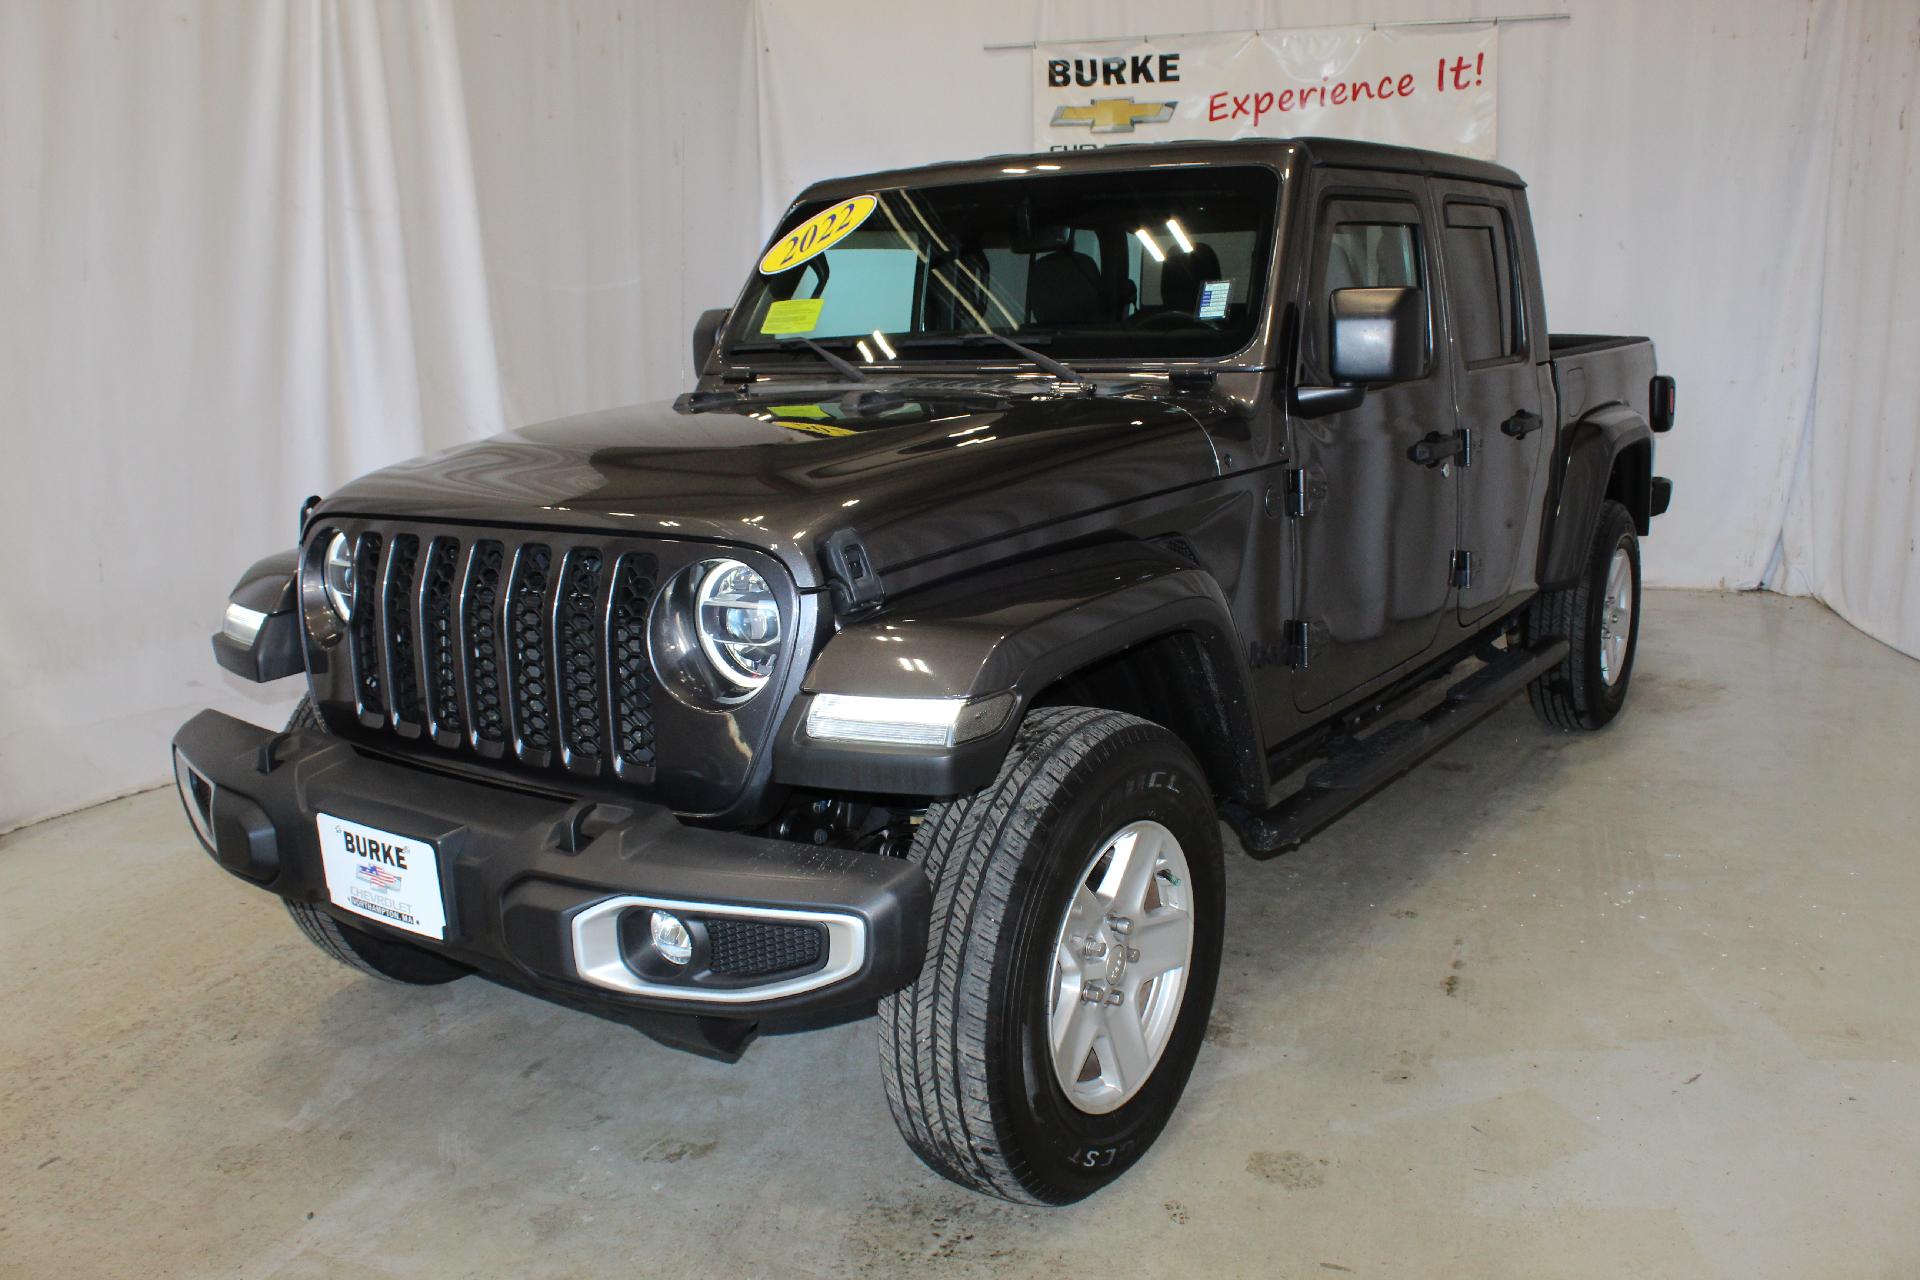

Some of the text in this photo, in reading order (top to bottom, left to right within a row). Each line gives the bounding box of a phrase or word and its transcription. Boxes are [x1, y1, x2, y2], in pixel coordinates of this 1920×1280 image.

[1049, 53, 1180, 87] BURKE
[1208, 52, 1485, 127] Experience It!
[780, 203, 855, 265] 2022
[344, 831, 408, 870] BURKE
[350, 886, 413, 913] CHEVROLET
